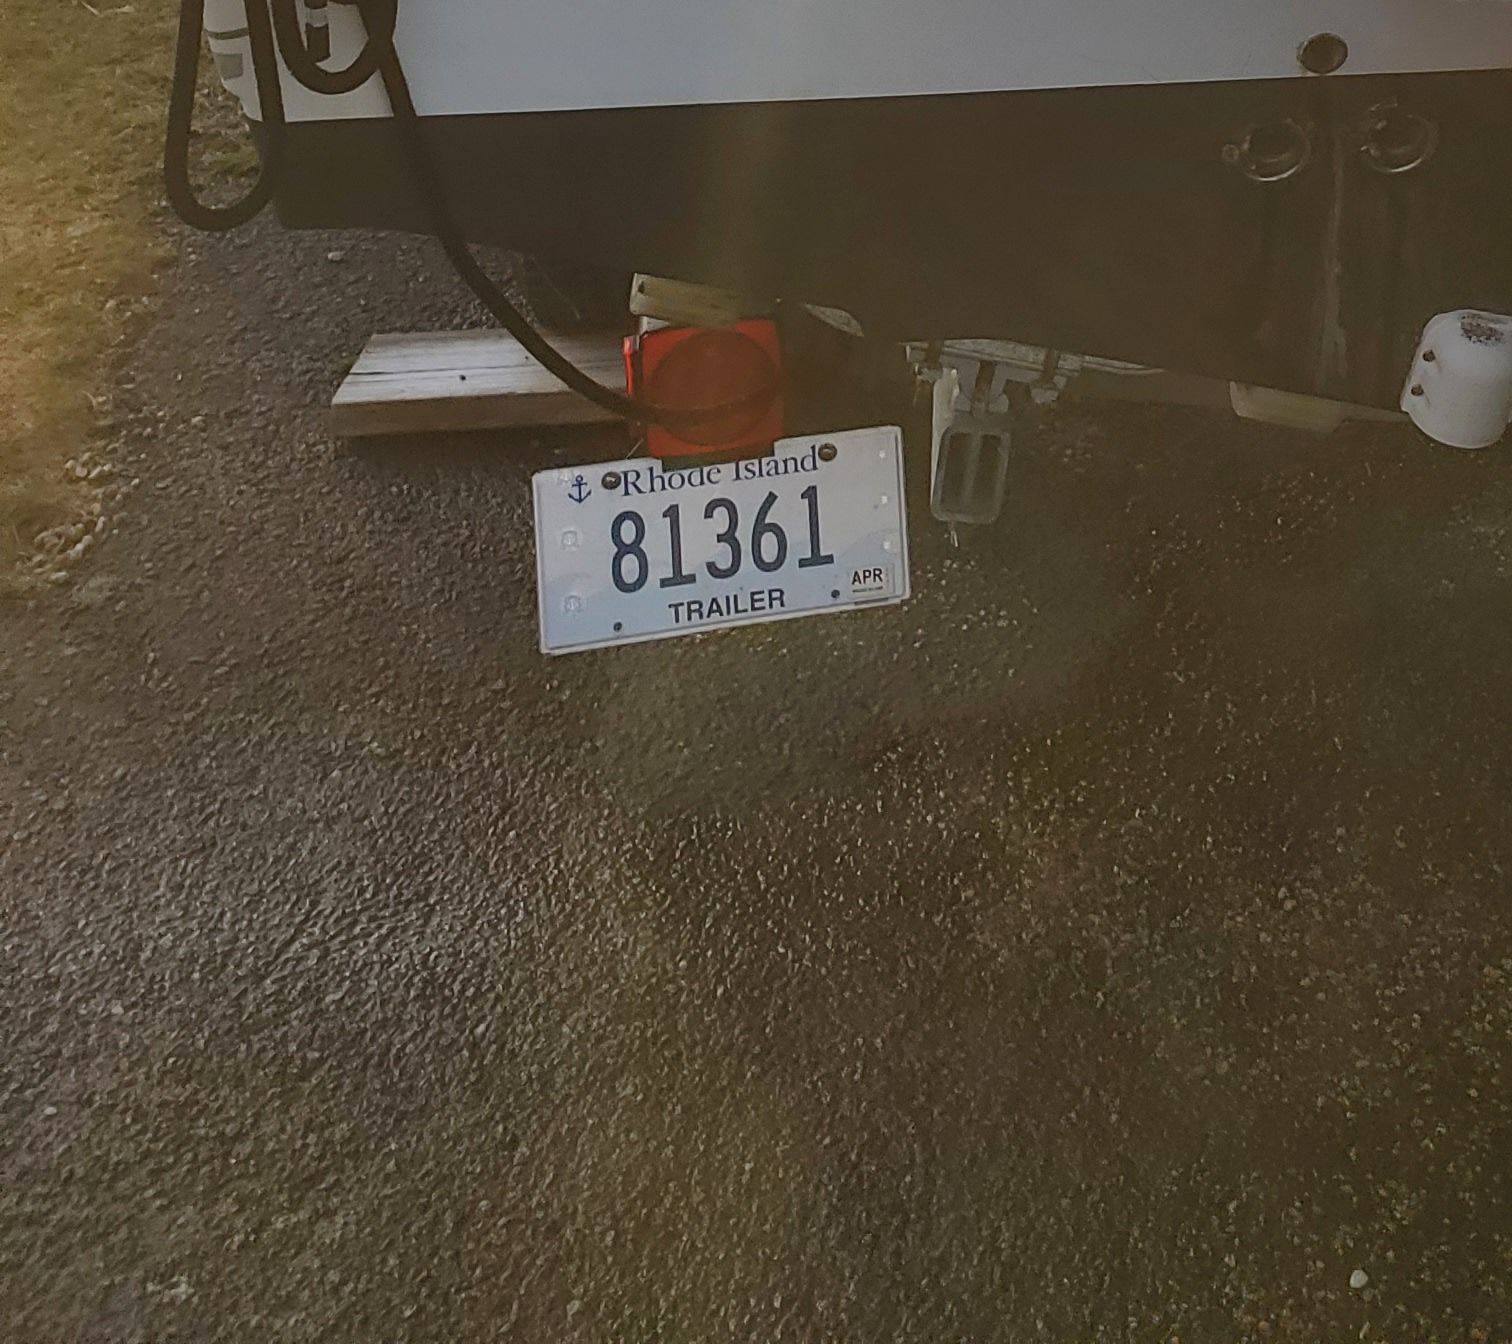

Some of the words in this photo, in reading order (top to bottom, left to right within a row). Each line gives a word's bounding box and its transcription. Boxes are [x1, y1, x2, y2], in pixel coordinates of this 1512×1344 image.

[621, 465, 721, 497] Rhode
[732, 444, 819, 481] Island
[610, 484, 835, 595] 81361
[851, 567, 884, 585] APR
[668, 588, 786, 624] TRAILER
